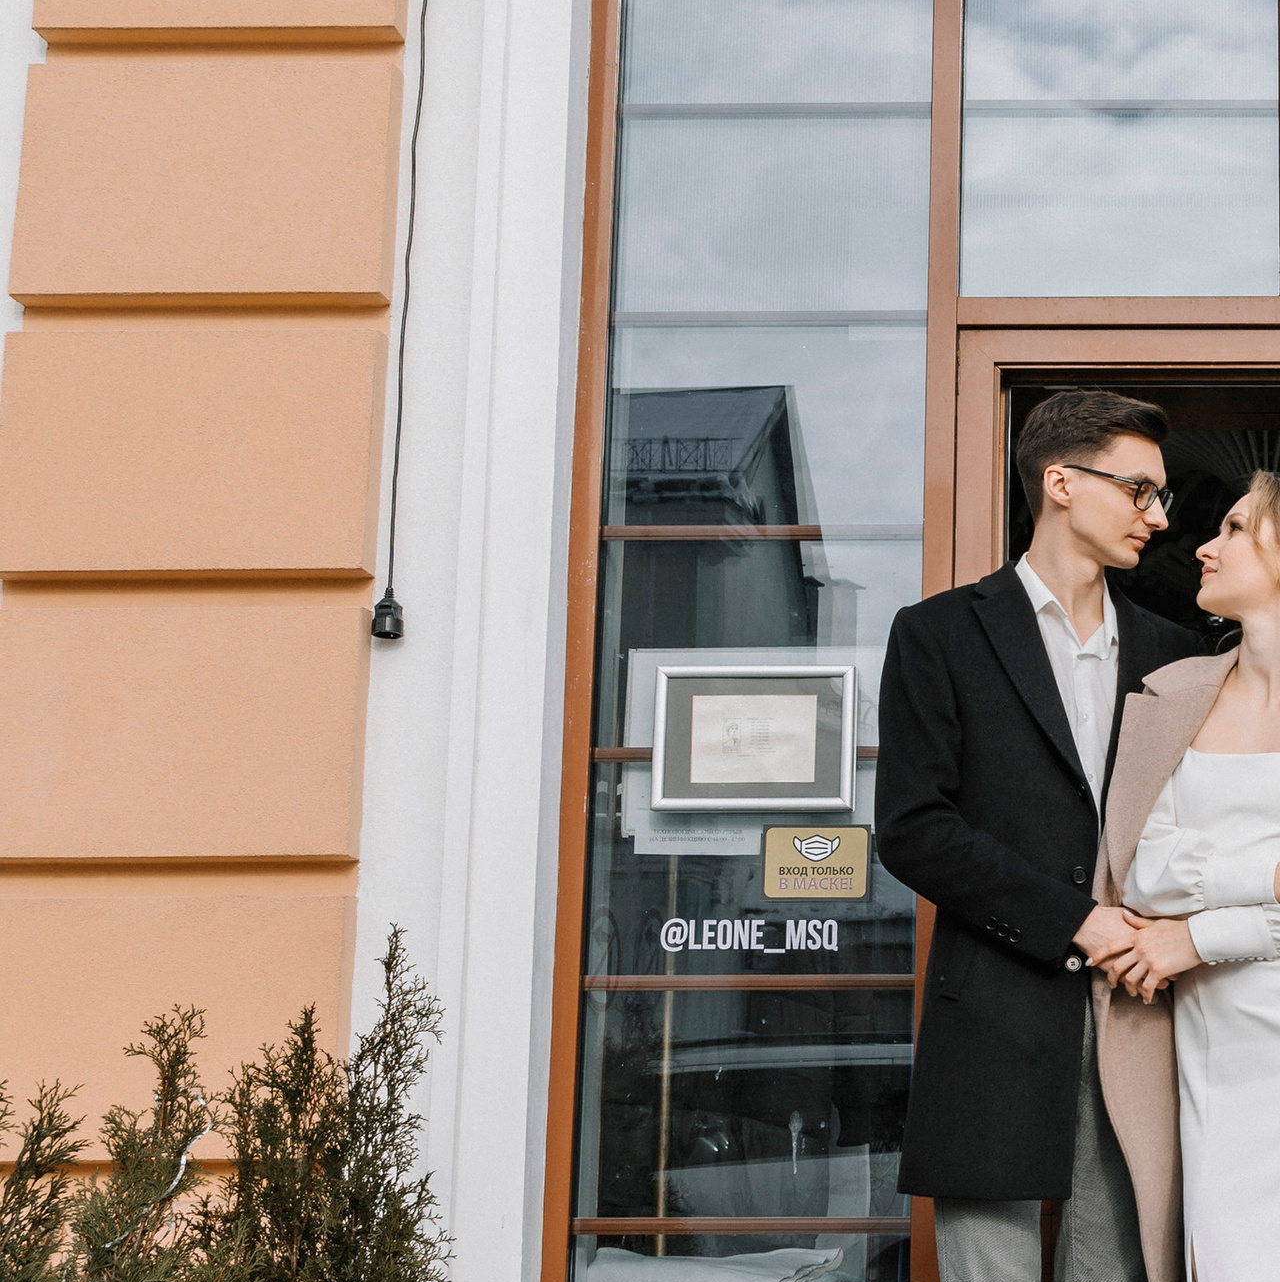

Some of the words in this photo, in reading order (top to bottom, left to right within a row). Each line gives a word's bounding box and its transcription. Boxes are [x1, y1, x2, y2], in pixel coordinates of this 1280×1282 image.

[778, 866, 808, 877] ВХОД
[811, 866, 854, 876] ТОЛЬКО
[778, 877, 789, 891] В
[793, 877, 853, 891] МАСКЕ!
[660, 917, 838, 953] @LEONE_MSQ
